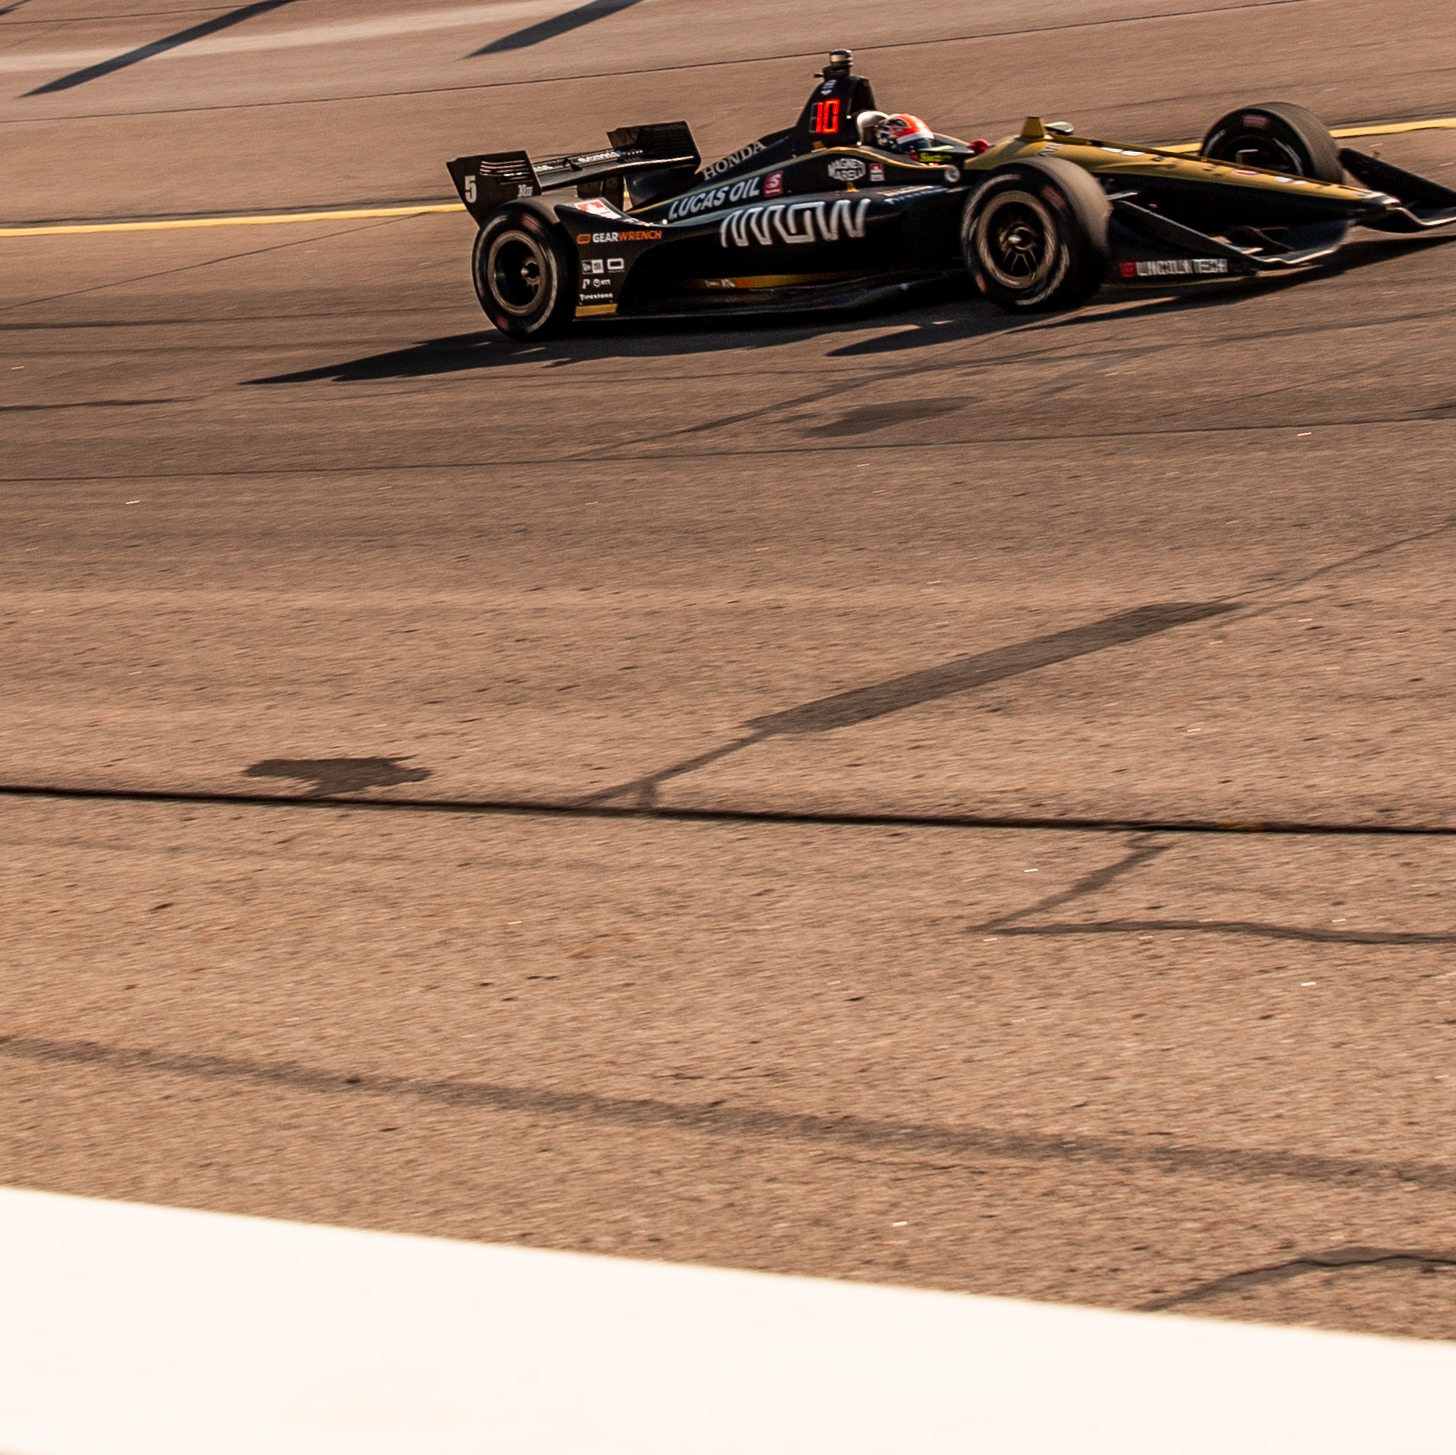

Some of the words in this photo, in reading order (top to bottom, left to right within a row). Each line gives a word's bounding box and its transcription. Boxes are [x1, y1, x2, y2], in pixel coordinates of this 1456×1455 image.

[815, 98, 840, 134] 10
[701, 140, 767, 181] HONDA
[464, 175, 477, 204] 5
[668, 185, 728, 220] LUCAS
[729, 177, 760, 202] OIL
[592, 230, 662, 243] GEARWRENCH
